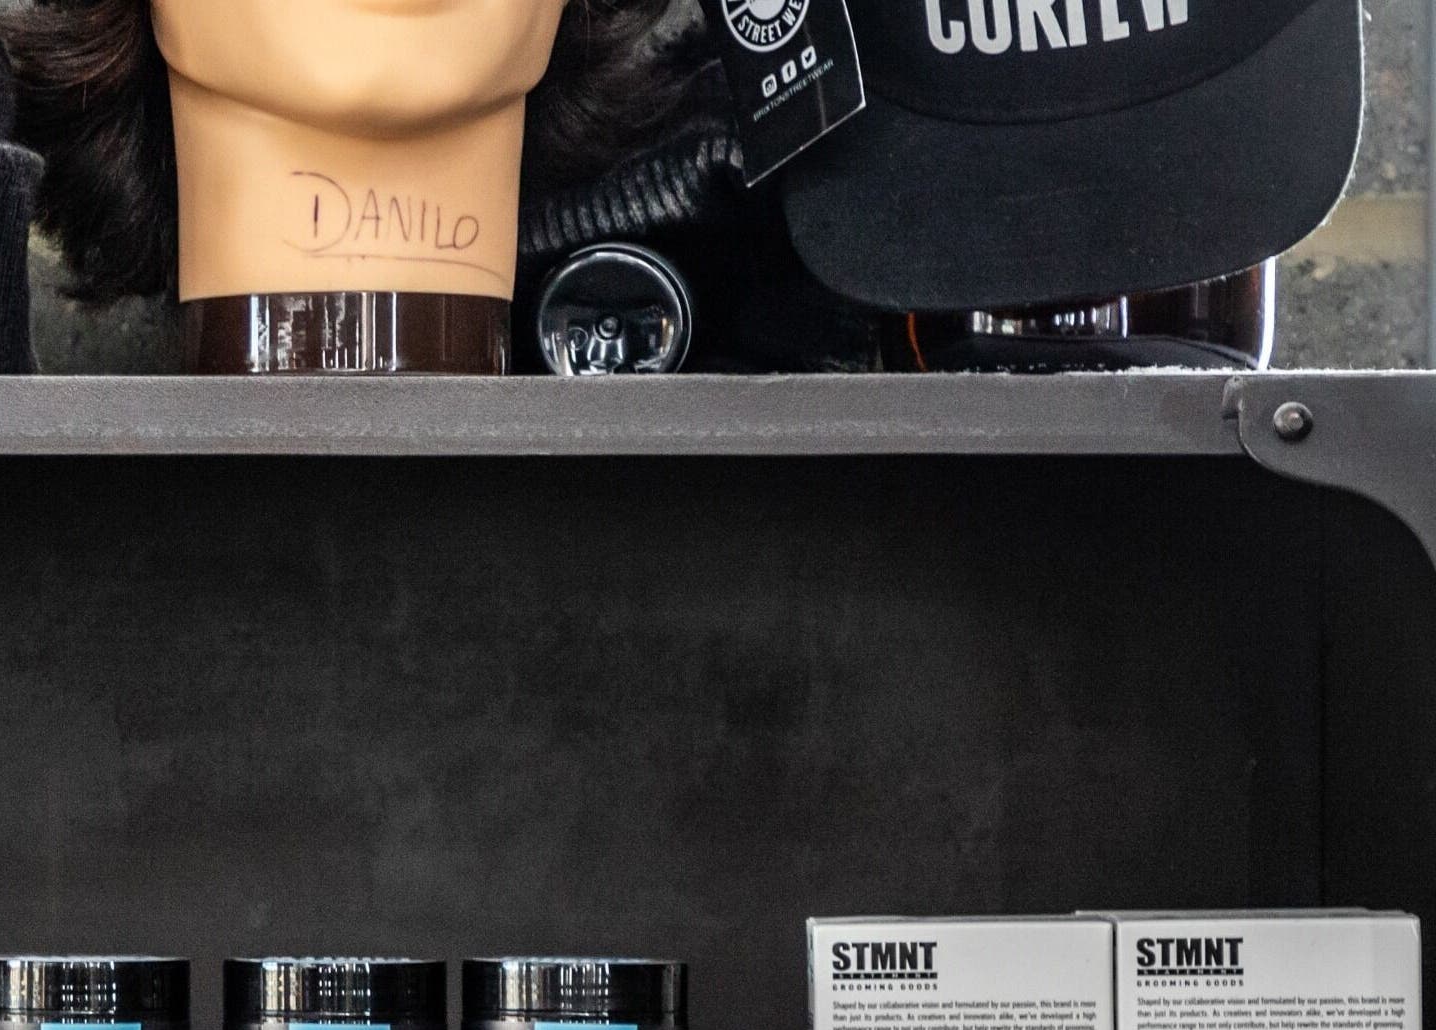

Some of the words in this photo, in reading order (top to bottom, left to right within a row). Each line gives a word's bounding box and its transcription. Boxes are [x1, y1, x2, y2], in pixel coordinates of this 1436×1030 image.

[738, 15, 782, 43] STREET
[282, 171, 479, 252] DANILO
[832, 942, 938, 971] STMNT
[1136, 937, 1244, 967] STMNT
